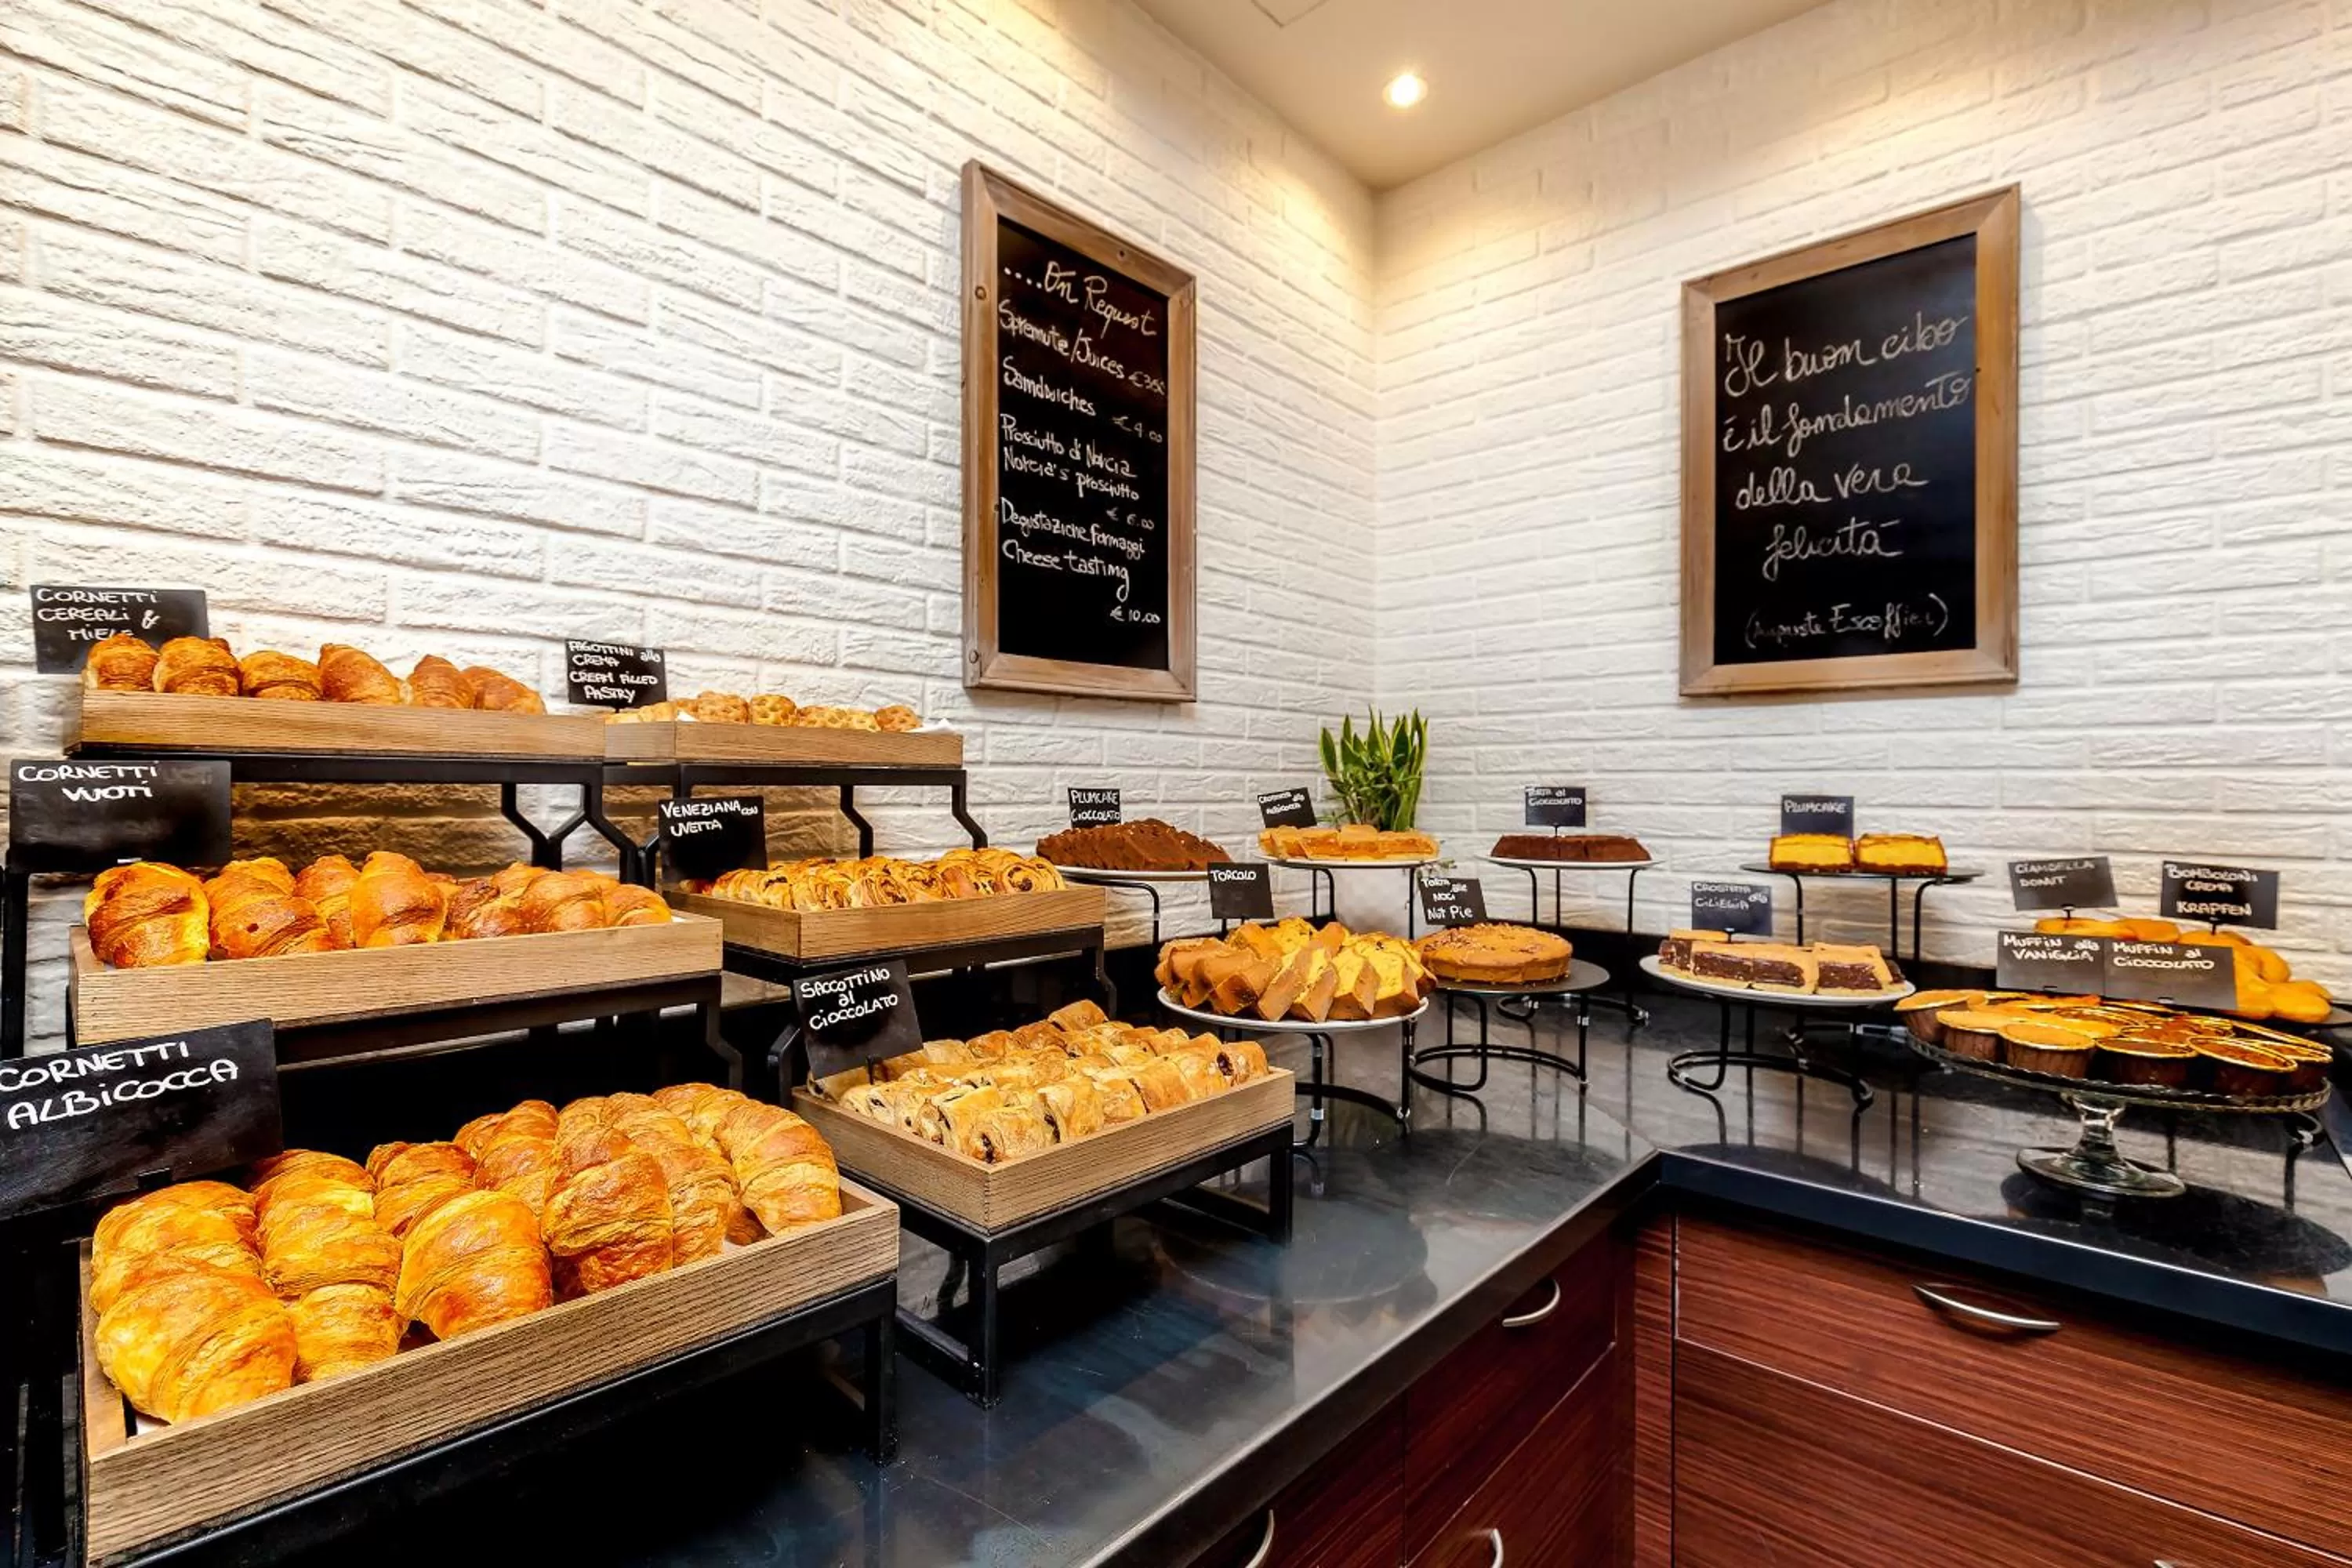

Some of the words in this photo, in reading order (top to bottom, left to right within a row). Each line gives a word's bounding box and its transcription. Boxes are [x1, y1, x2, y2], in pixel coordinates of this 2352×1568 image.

[1083, 275, 1157, 339] Request
[1784, 337, 1878, 382] buon
[1882, 310, 1969, 360] cibo
[1000, 413, 1065, 455] Prosciutto
[1086, 439, 1138, 477] Norcia
[1747, 403, 1783, 450] il
[1781, 369, 1972, 458] fondamento
[1000, 496, 1091, 543] Degustazione
[1735, 466, 1832, 510] della
[1002, 539, 1063, 571] Cheese
